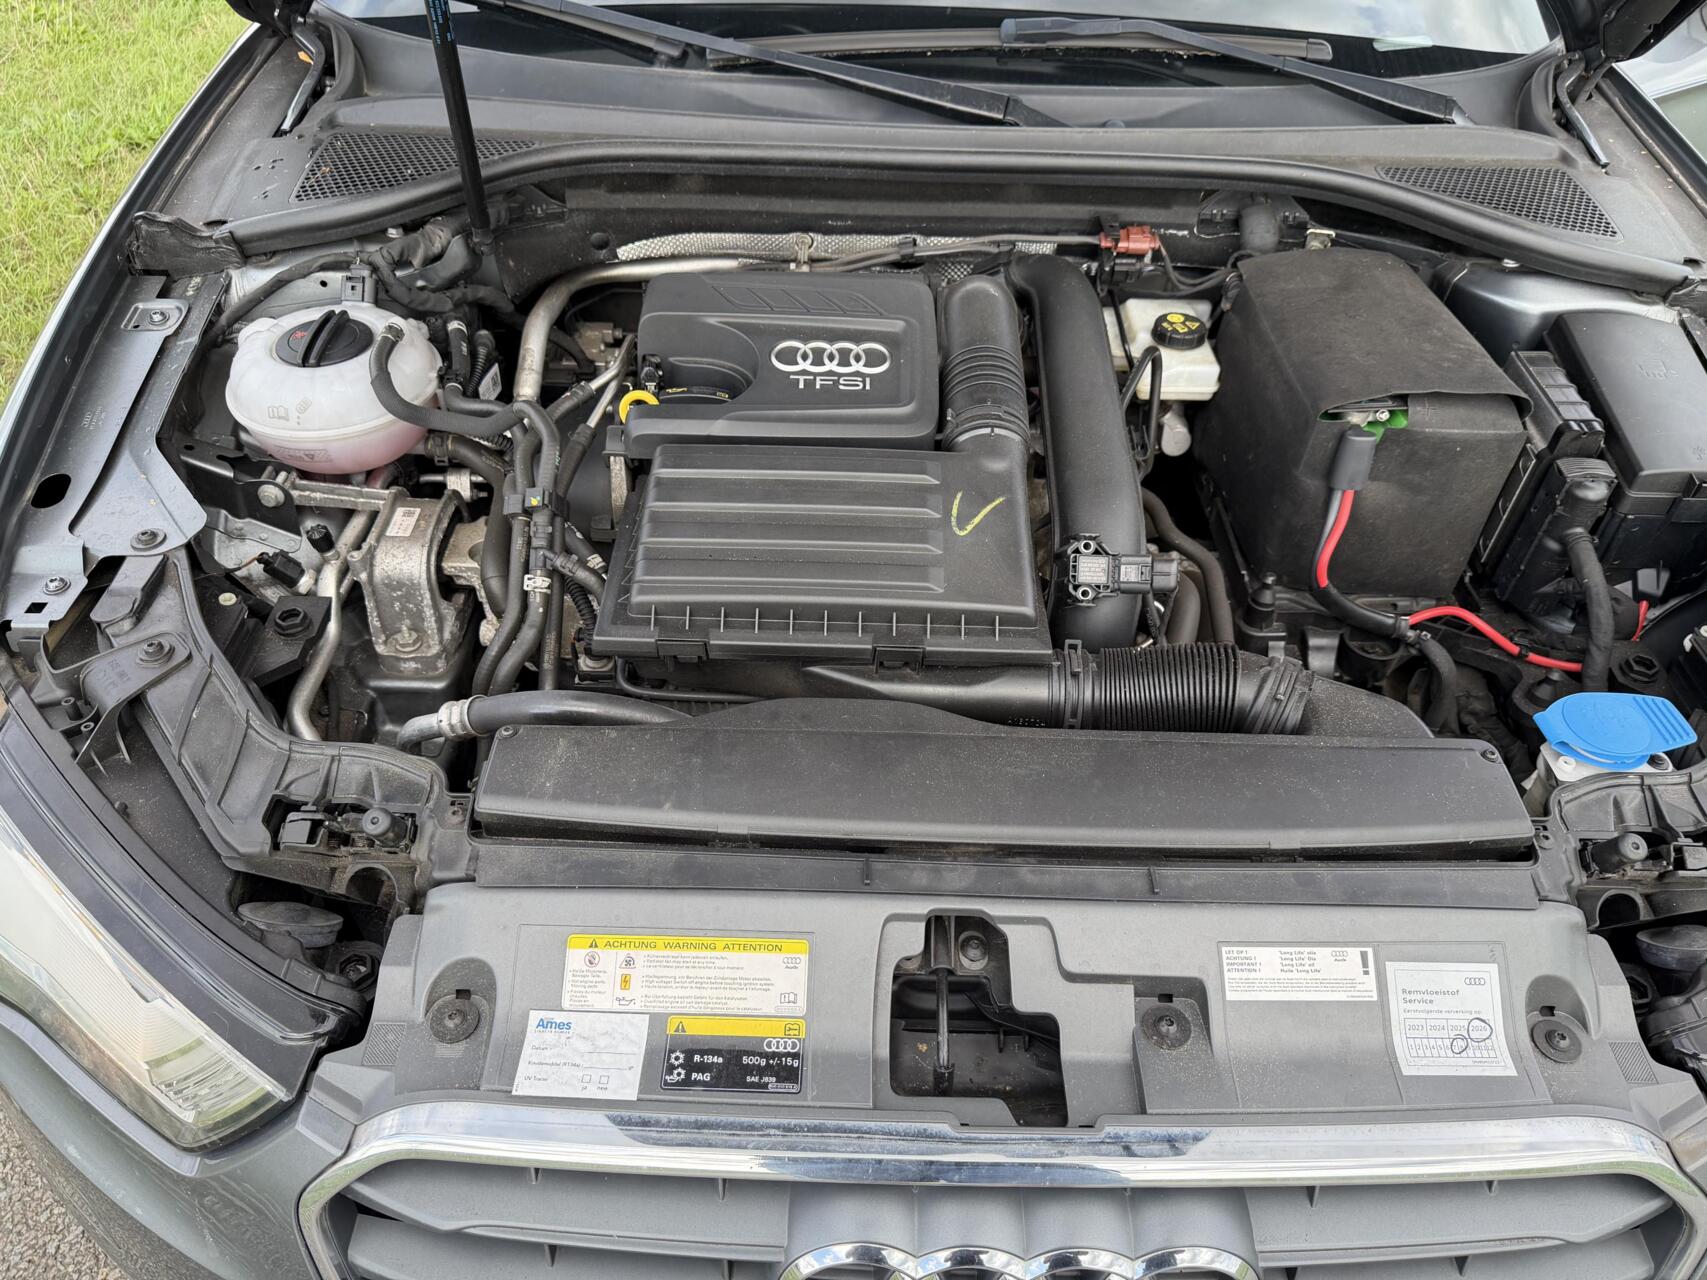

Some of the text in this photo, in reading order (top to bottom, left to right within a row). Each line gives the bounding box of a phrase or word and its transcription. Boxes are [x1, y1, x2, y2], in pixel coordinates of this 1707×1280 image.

[790, 375, 871, 390] TFSI
[604, 940, 782, 952] ACHTUNG WARNING ATTENTION
[536, 1018, 572, 1030] Ames
[694, 1055, 723, 1063] R-134a
[742, 1056, 766, 1066] 500g
